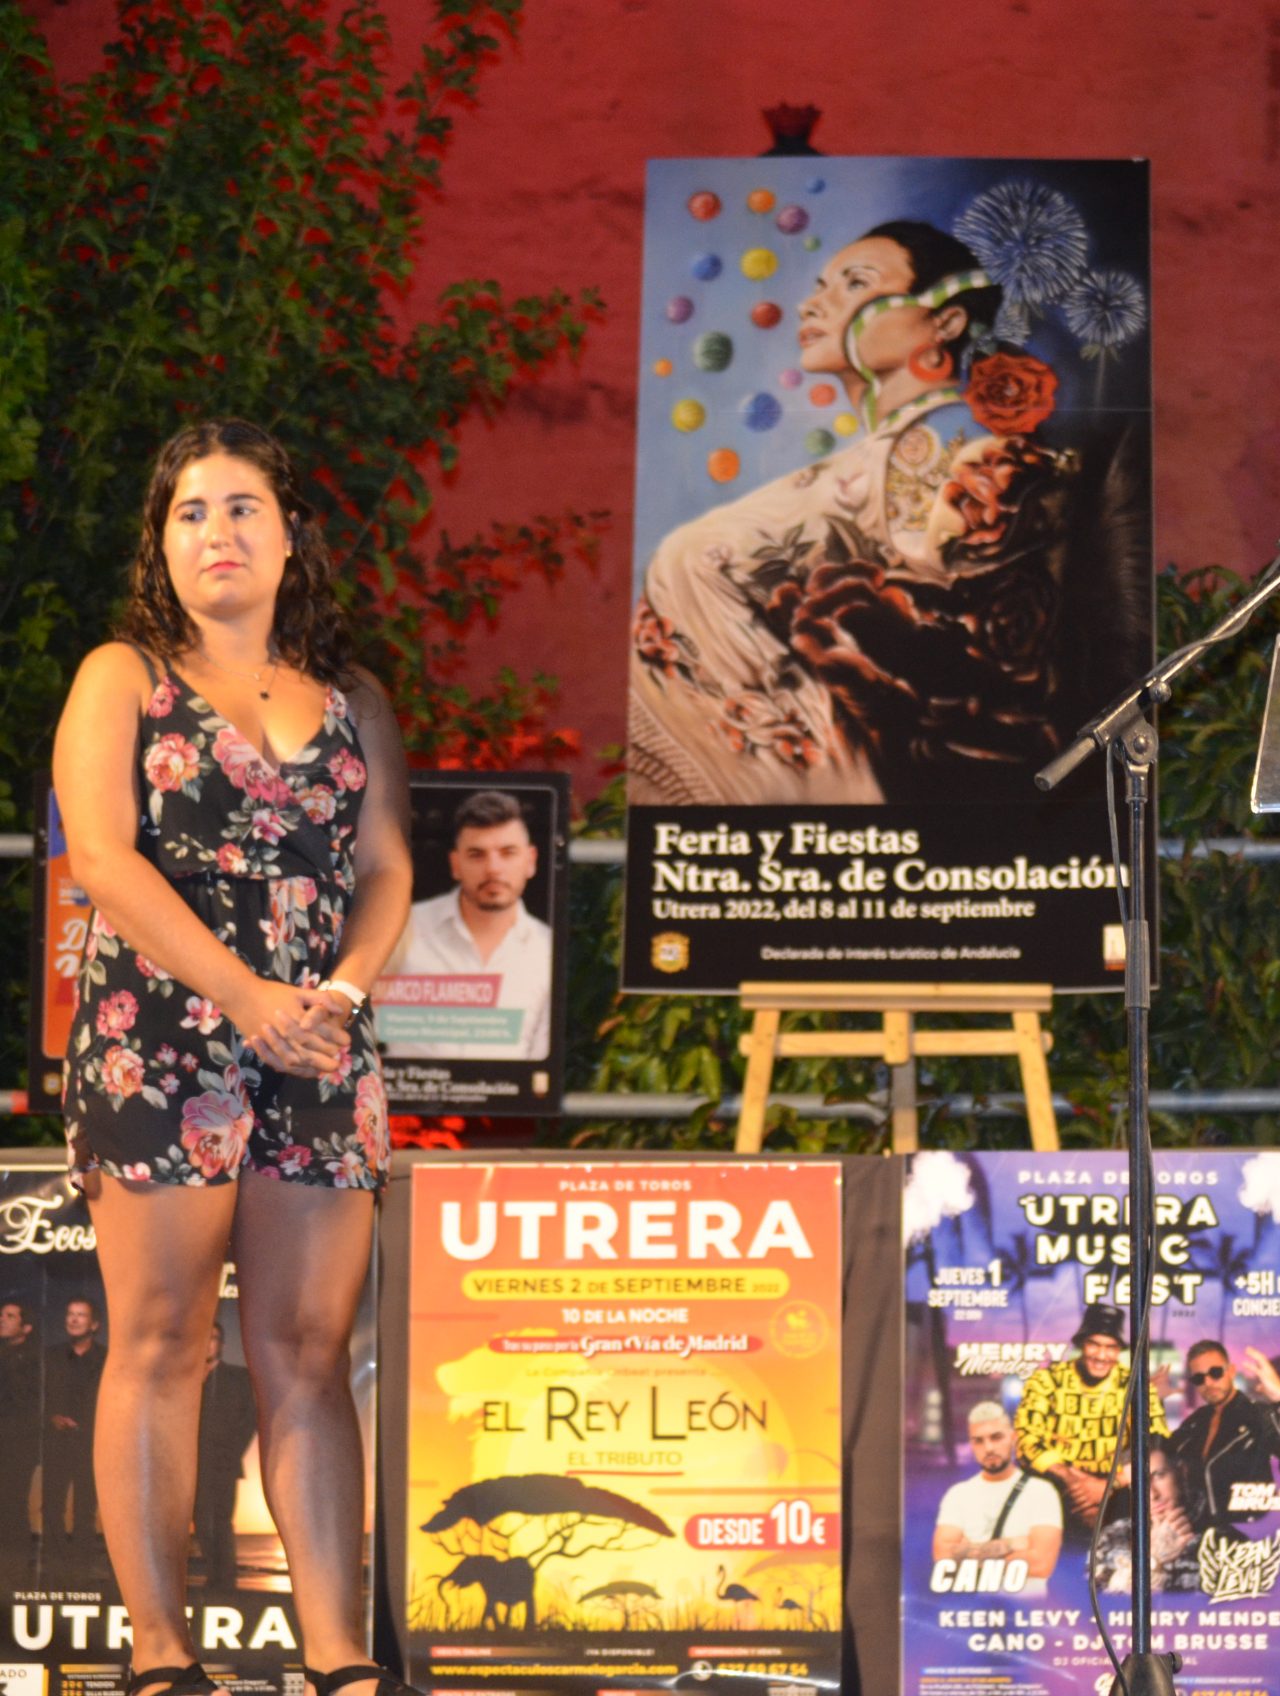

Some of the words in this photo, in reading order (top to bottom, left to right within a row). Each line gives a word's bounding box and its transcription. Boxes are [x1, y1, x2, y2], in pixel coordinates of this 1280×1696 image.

[653, 823, 751, 856] Feria
[759, 830, 783, 861] y
[790, 823, 920, 856] Fiestas
[652, 860, 752, 892] Ntra.
[759, 860, 833, 892] Sra.
[839, 859, 887, 892] de
[893, 855, 1131, 892] Consolación
[652, 900, 721, 920] Utrera
[724, 900, 781, 922] 2022,
[783, 899, 816, 919] del
[819, 899, 834, 919] 8
[837, 899, 858, 919] al
[861, 899, 886, 919] 11
[889, 899, 917, 919] de
[920, 898, 1036, 924] septiembre
[826, 946, 843, 960] de
[941, 946, 957, 960] de
[423, 981, 493, 1004] FLAMENCO
[559, 1180, 609, 1192] PLAZA
[613, 1180, 635, 1192] DE
[640, 1180, 692, 1192] TOROS
[1018, 1170, 1093, 1185] PLAZA
[1103, 1170, 1130, 1185] DE
[1157, 1170, 1219, 1186] OROS
[1019, 1195, 1219, 1227] UTRRA
[440, 1200, 814, 1261] UTRERA
[1035, 1234, 1190, 1265] MUSC
[934, 1267, 986, 1286] JUEVES
[987, 1259, 1003, 1287] 1
[1235, 1269, 1275, 1296] +5H
[473, 1279, 564, 1293] VIERNES
[571, 1278, 582, 1293] 2
[588, 1281, 608, 1293] DE
[613, 1278, 746, 1293] SEPTIEMBRE
[1085, 1274, 1203, 1305] FEST
[928, 1289, 1009, 1308] SEPTIEMBRE
[561, 1308, 581, 1324] 10
[584, 1310, 604, 1324] DE
[607, 1310, 626, 1324] LA
[629, 1308, 689, 1324] NOCHE
[580, 1336, 623, 1358] Gran
[662, 1336, 685, 1351] de
[679, 1334, 748, 1359] Madrid
[957, 1342, 1068, 1362] HENRY
[483, 1401, 525, 1432] EL
[567, 1451, 590, 1466] EL
[596, 1451, 683, 1466] TRIBUTO
[1230, 1483, 1277, 1498] TOM
[698, 1517, 764, 1546] DESDE
[929, 1557, 1029, 1594] CANO
[14, 1591, 47, 1601] PLAZA
[49, 1591, 64, 1601] DE
[66, 1592, 102, 1601] TOROS
[13, 1604, 298, 1651] UTRRA
[939, 1609, 1006, 1628] KEEN
[1015, 1609, 1081, 1628] LEVY
[968, 1634, 1045, 1651] CANO
[1073, 1634, 1101, 1651] DJ
[1112, 1634, 1165, 1650] TM
[1173, 1633, 1269, 1650] BRUSSE
[1071, 1656, 1112, 1667] OFICIA
